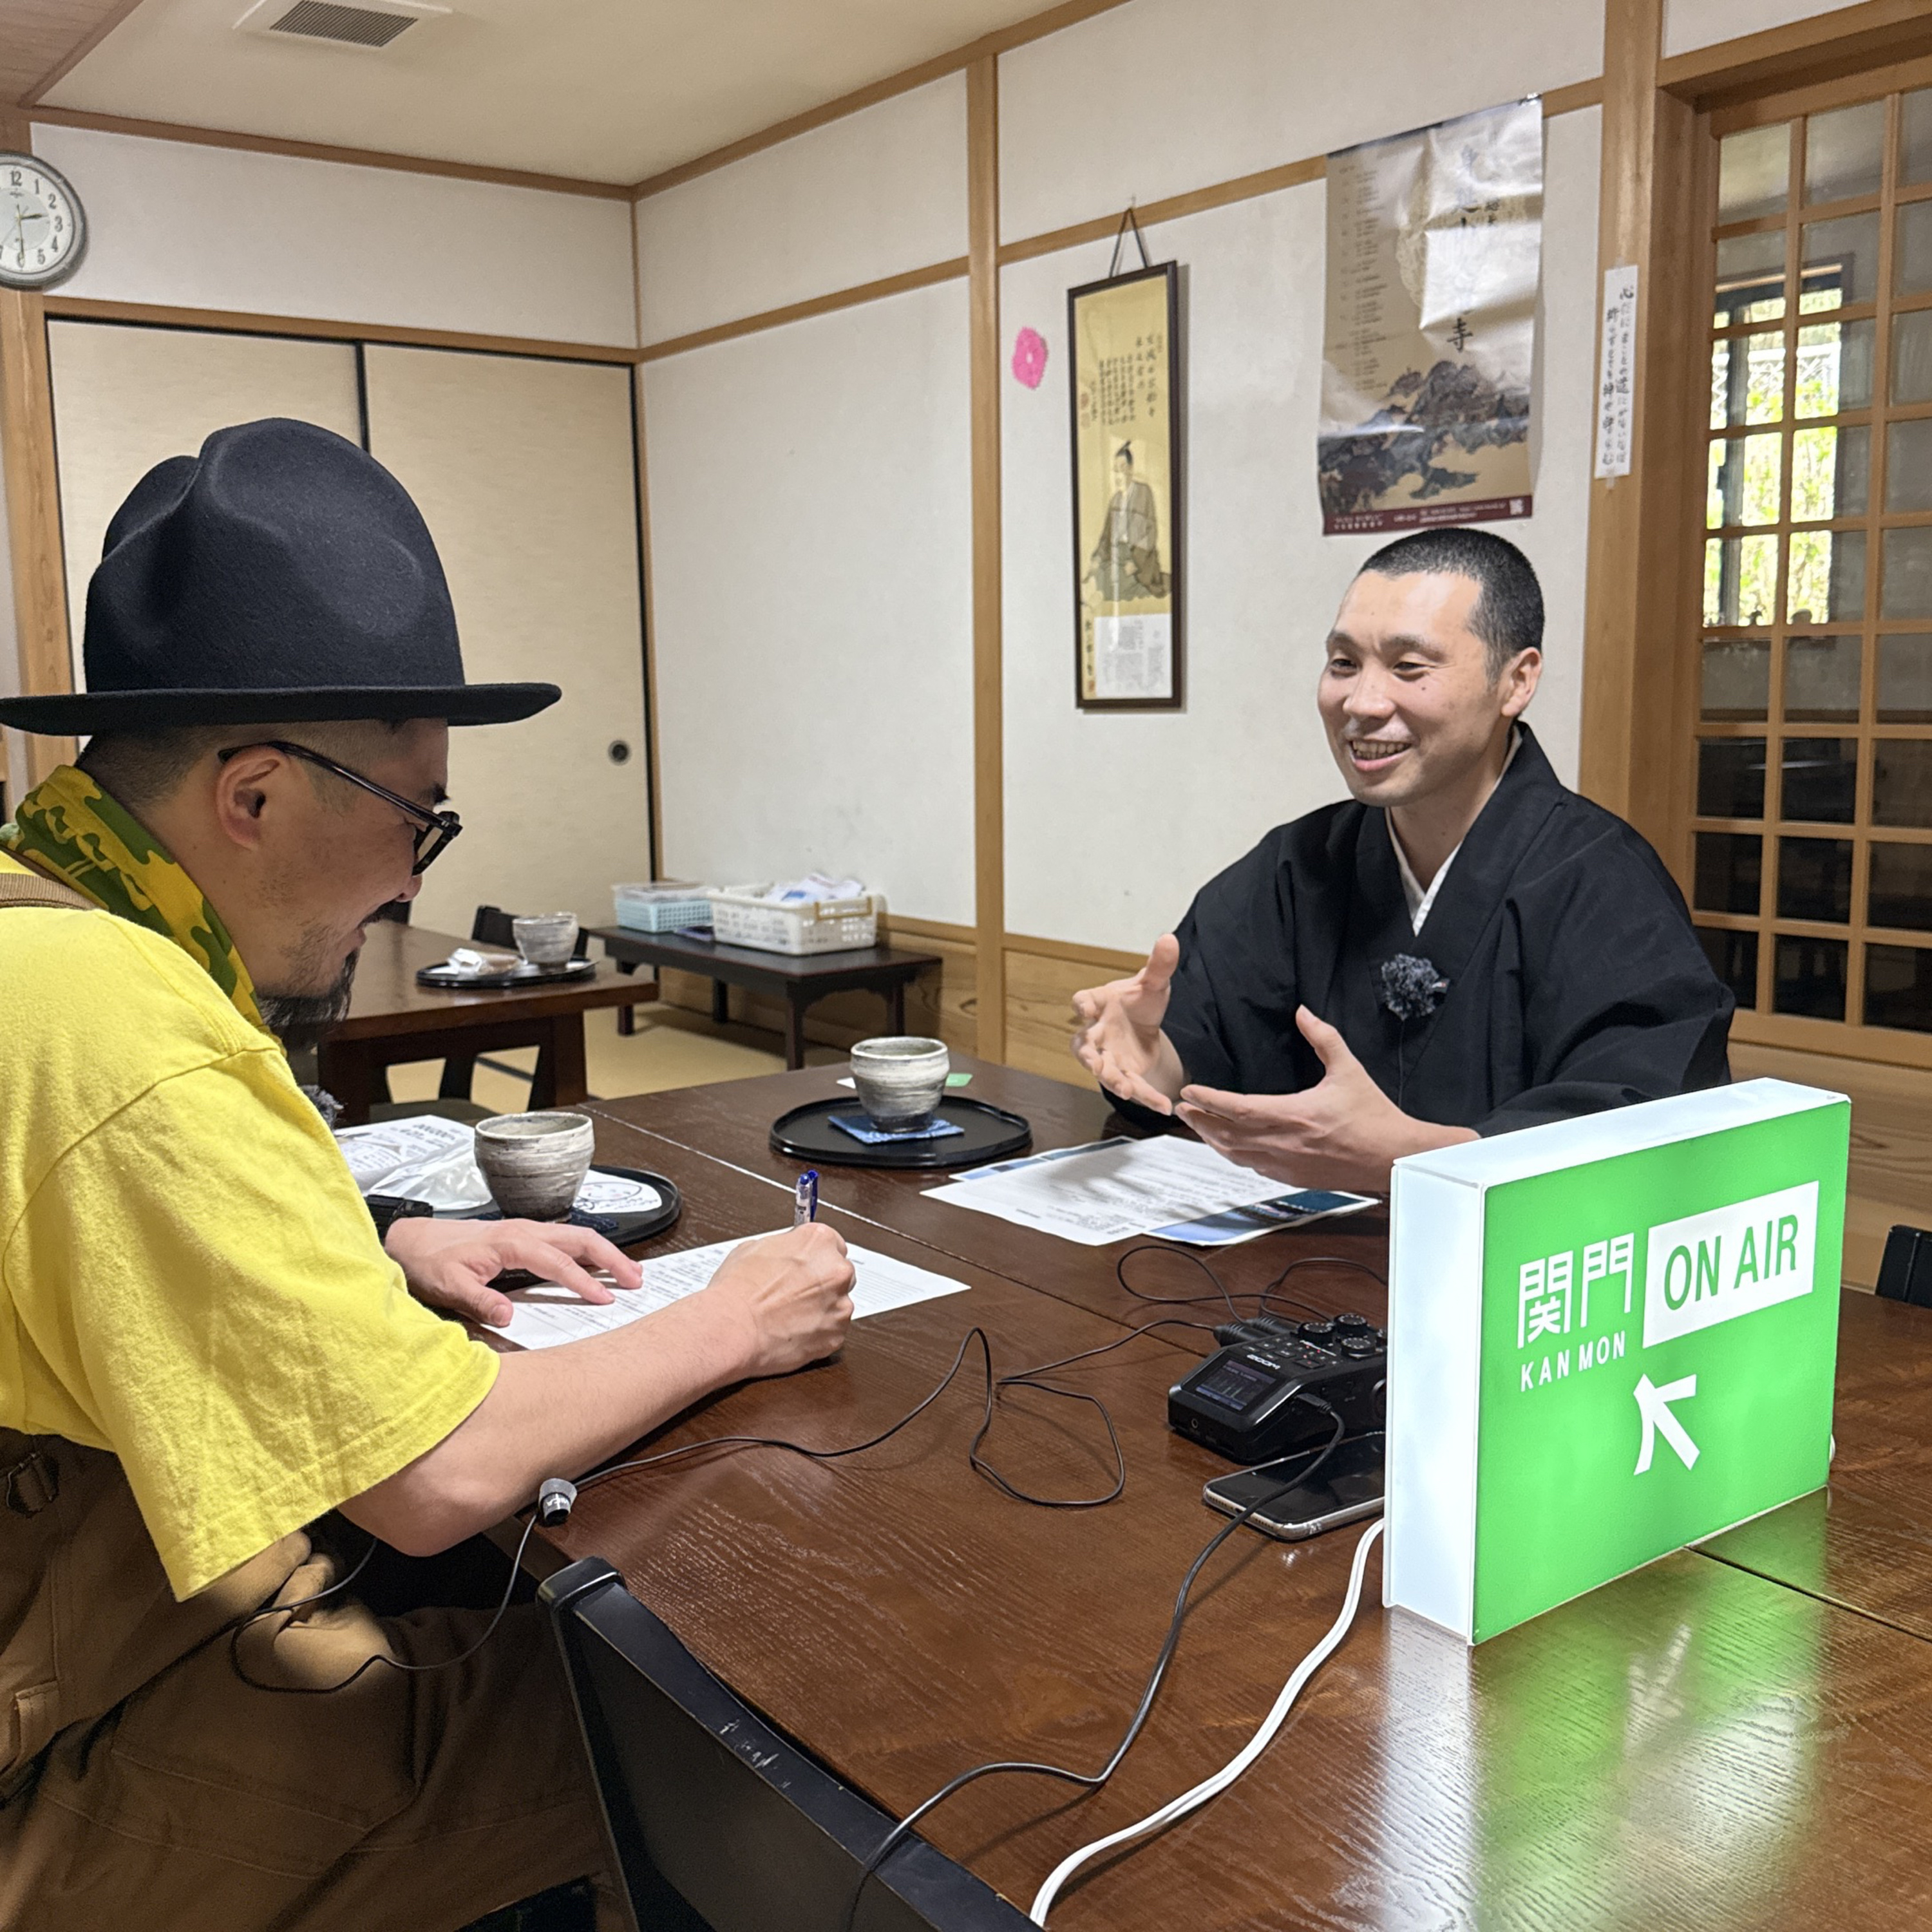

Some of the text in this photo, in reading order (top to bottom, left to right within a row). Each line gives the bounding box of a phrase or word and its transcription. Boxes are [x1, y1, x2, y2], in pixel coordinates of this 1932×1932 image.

[10, 171, 23, 186] 12
[35, 178, 40, 194] 1
[48, 193, 57, 209] 2
[55, 215, 63, 232] 3
[51, 236, 59, 252] 4
[37, 249, 46, 265] 5
[1664, 1214, 1799, 1311] ON AIR
[1517, 1232, 1634, 1349] 関門
[1520, 1330, 1625, 1392] KAN MON
